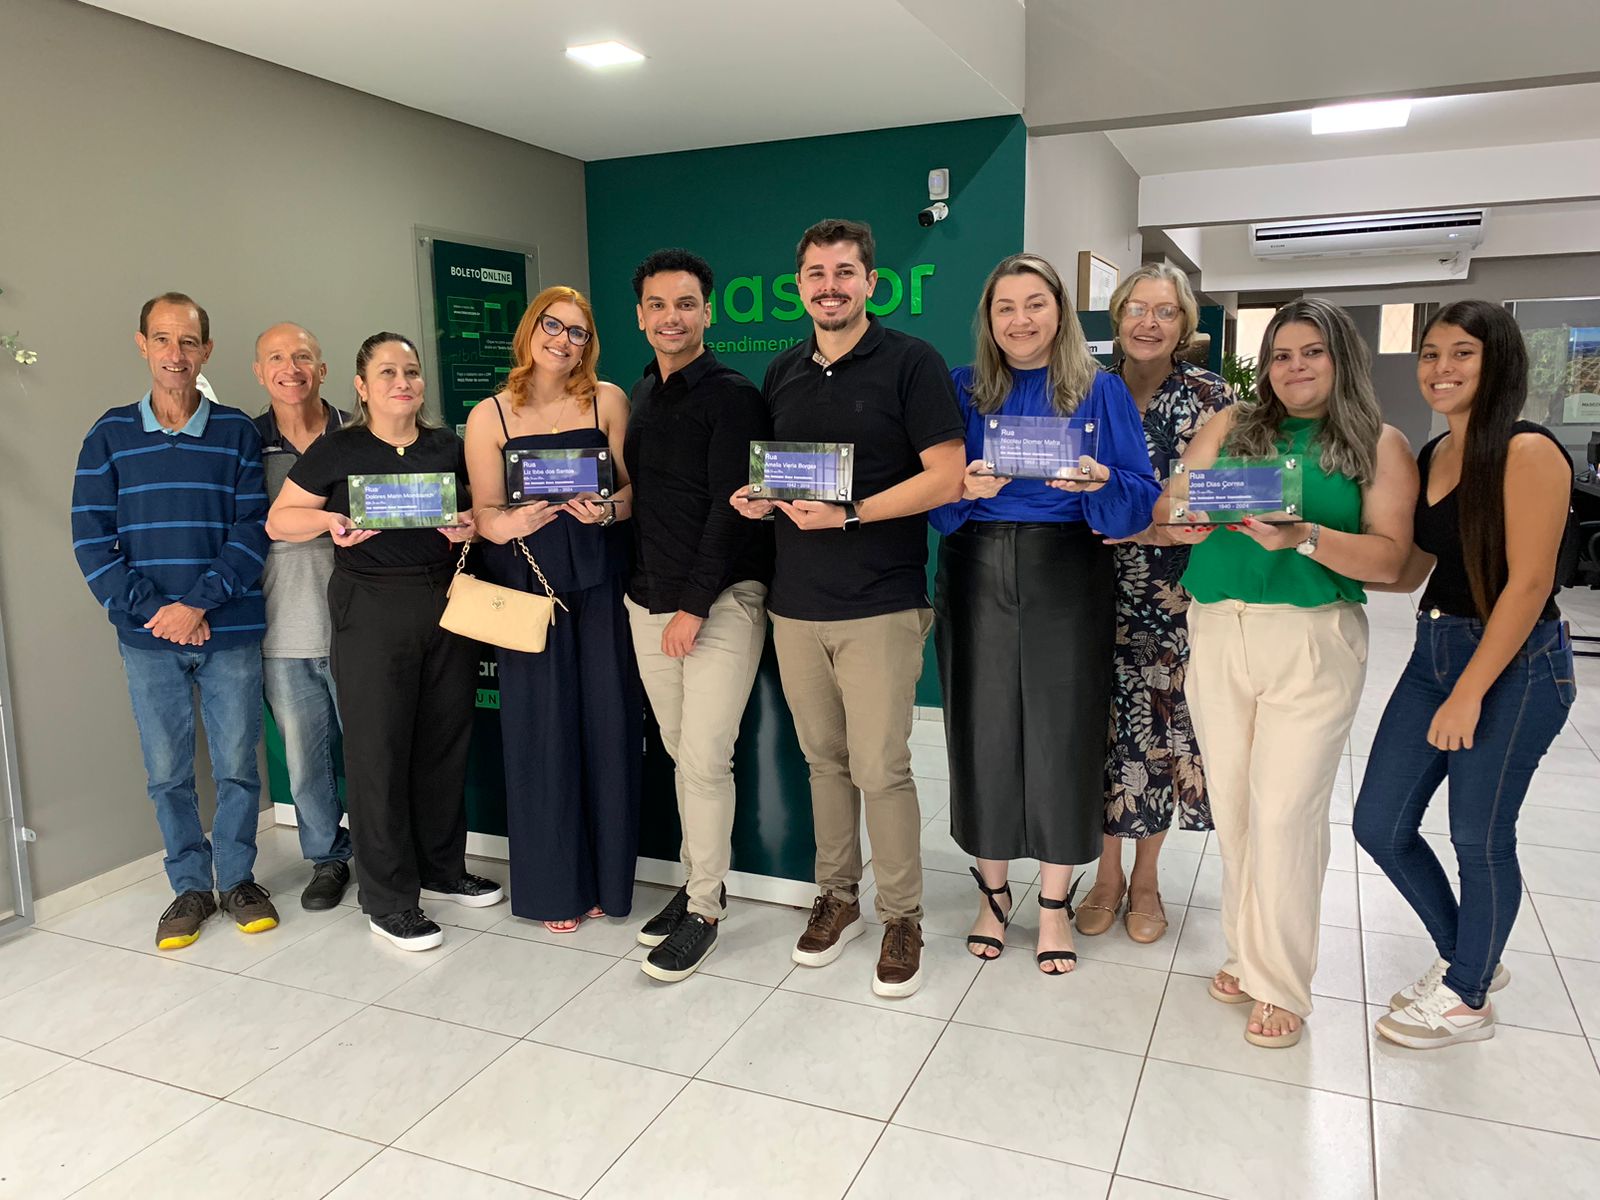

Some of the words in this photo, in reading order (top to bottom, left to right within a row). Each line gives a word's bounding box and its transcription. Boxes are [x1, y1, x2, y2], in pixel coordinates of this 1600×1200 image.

[450, 266, 480, 279] BOLETO
[482, 270, 511, 283] ONLINE
[1189, 472, 1205, 480] Rua
